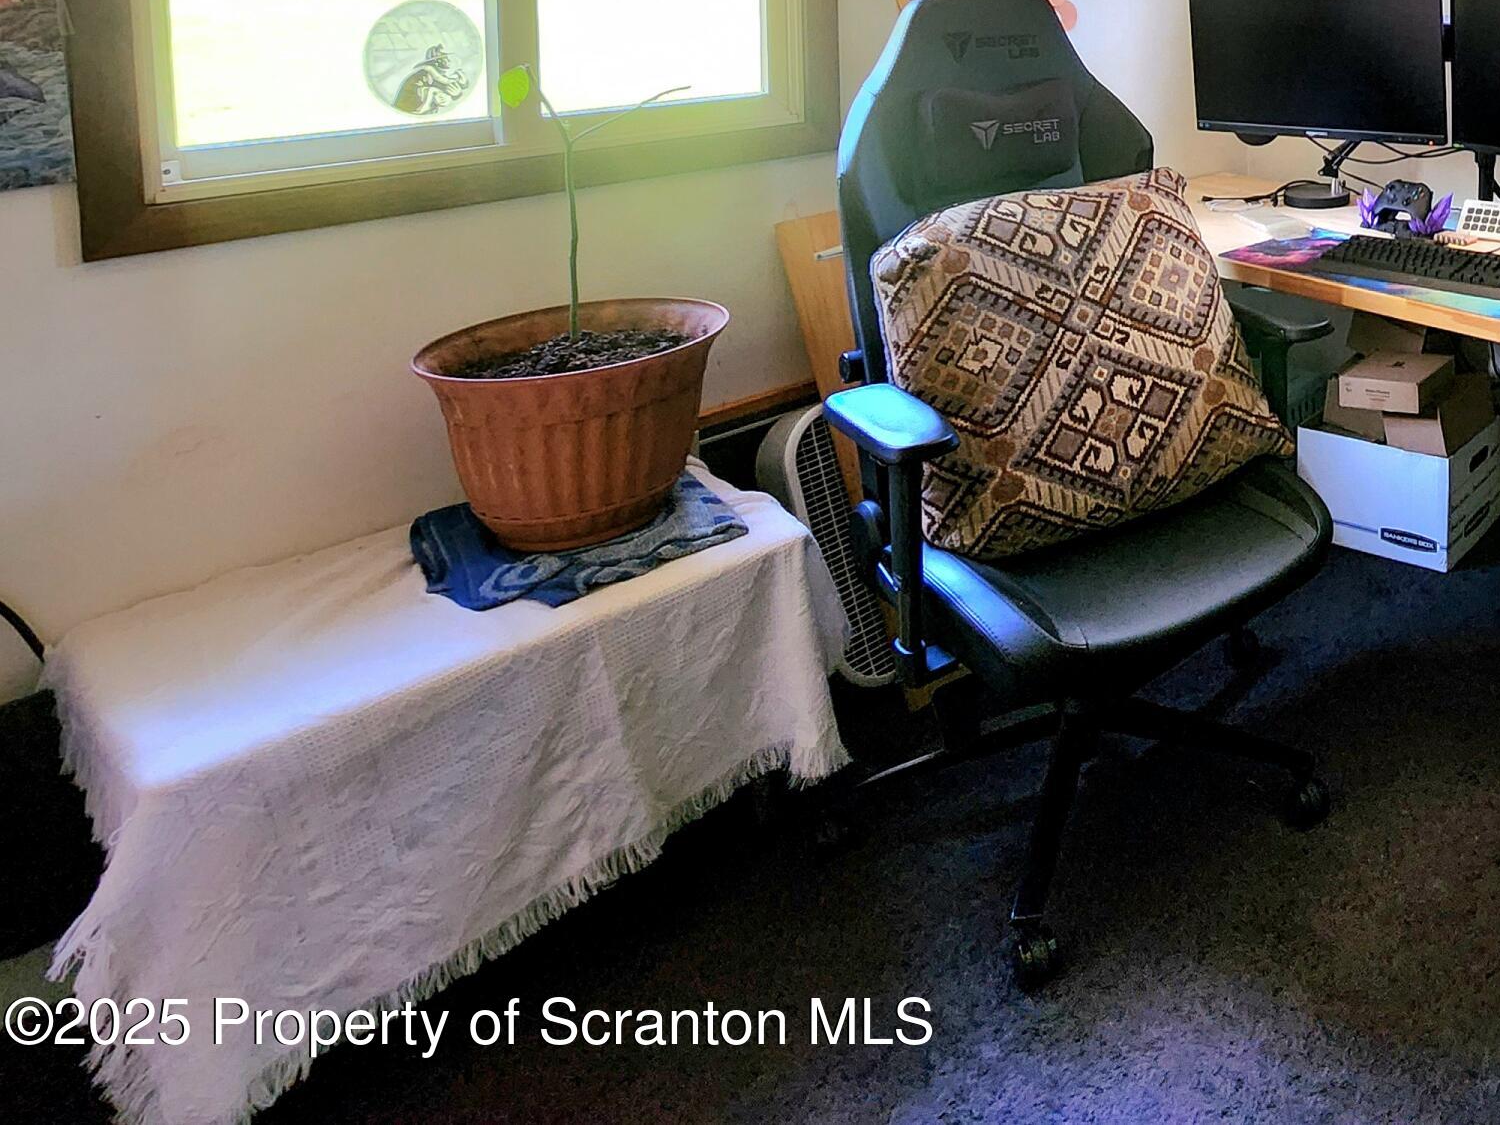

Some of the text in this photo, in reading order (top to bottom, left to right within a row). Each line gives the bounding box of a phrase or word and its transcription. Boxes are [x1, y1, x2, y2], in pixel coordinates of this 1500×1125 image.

[975, 33, 1038, 50] SECRET
[1008, 45, 1040, 60] LAB
[1002, 118, 1060, 135] SECRET
[1033, 130, 1060, 144] LAB
